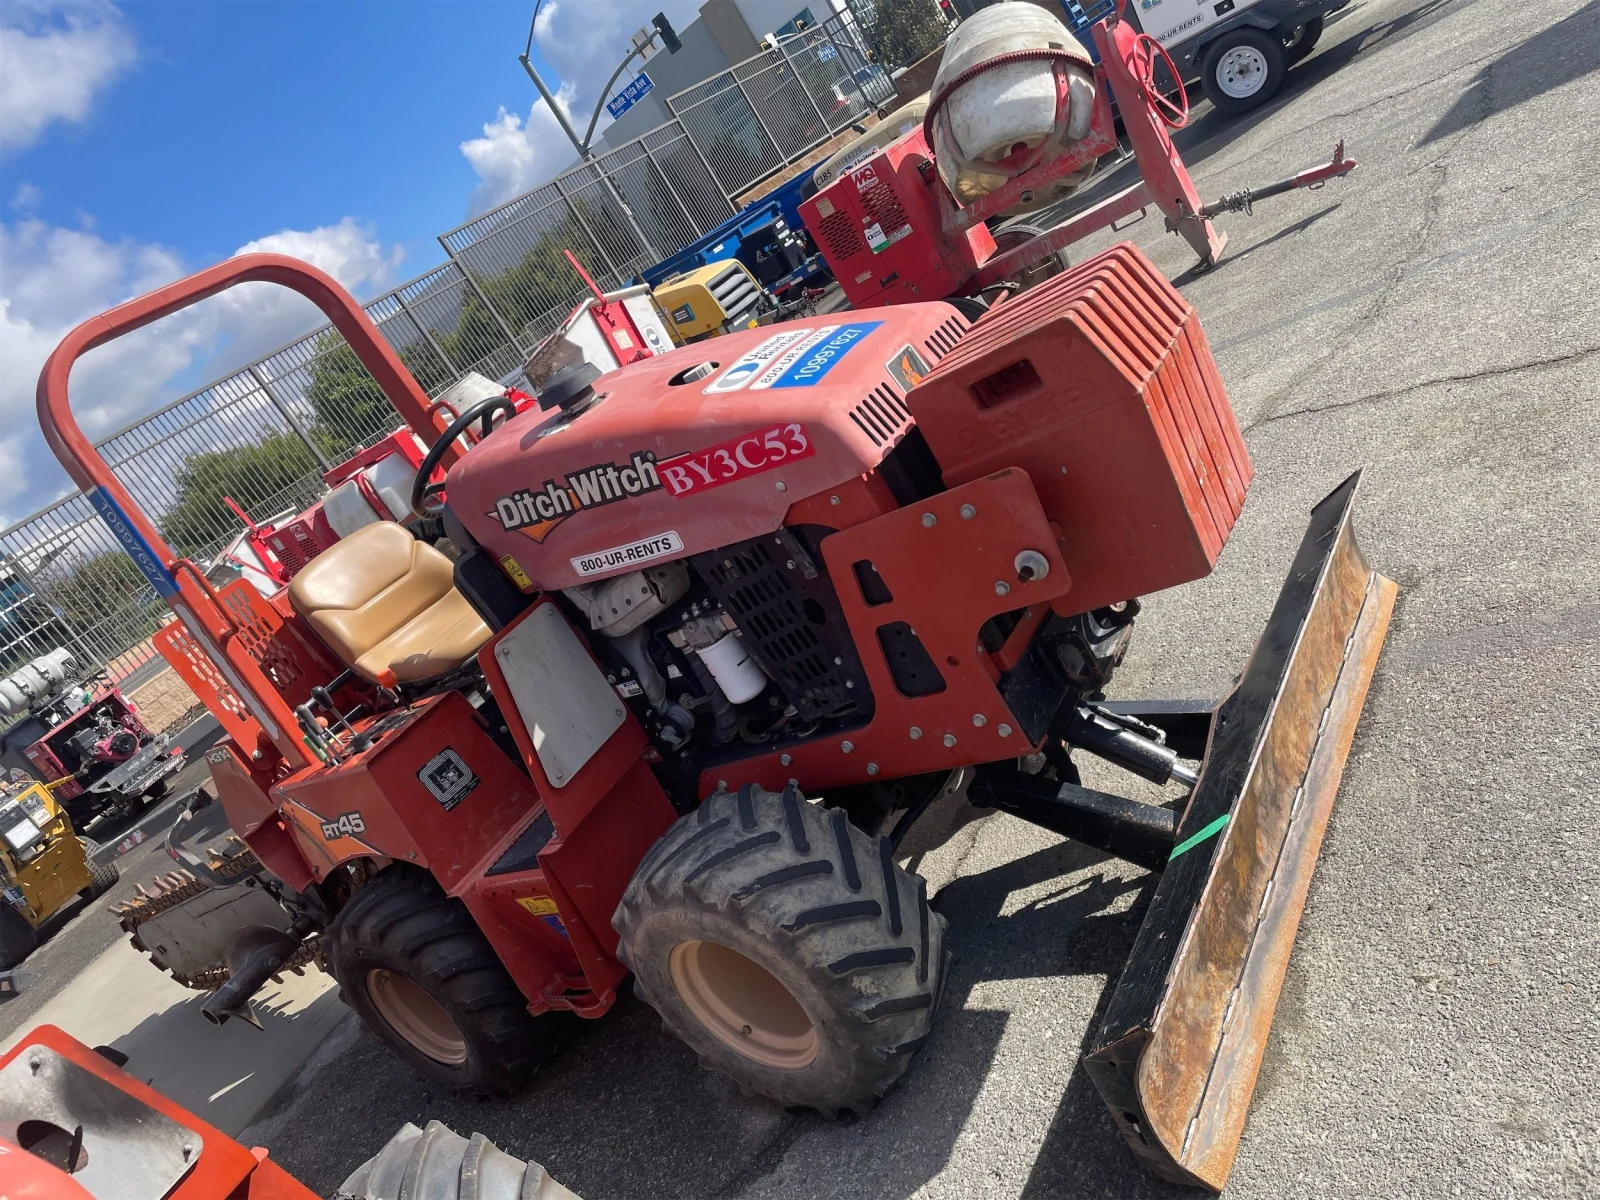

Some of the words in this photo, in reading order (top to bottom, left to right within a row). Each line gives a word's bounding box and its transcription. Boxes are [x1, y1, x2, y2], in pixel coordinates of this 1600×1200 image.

[610, 97, 627, 112] Monte
[622, 86, 638, 100] Vista
[634, 78, 647, 91] Ave
[816, 169, 832, 186] C185
[744, 335, 786, 362] United
[759, 331, 804, 360] Rentals
[761, 329, 832, 384] 800-UR-RENTS
[794, 328, 863, 381] 10997627
[661, 423, 808, 495] BY3C53
[496, 482, 571, 529] Ditch
[569, 456, 661, 506] Witch
[101, 502, 165, 582] 10997627
[581, 537, 671, 572] 800-UR-RENTS
[323, 813, 365, 839] RT45
